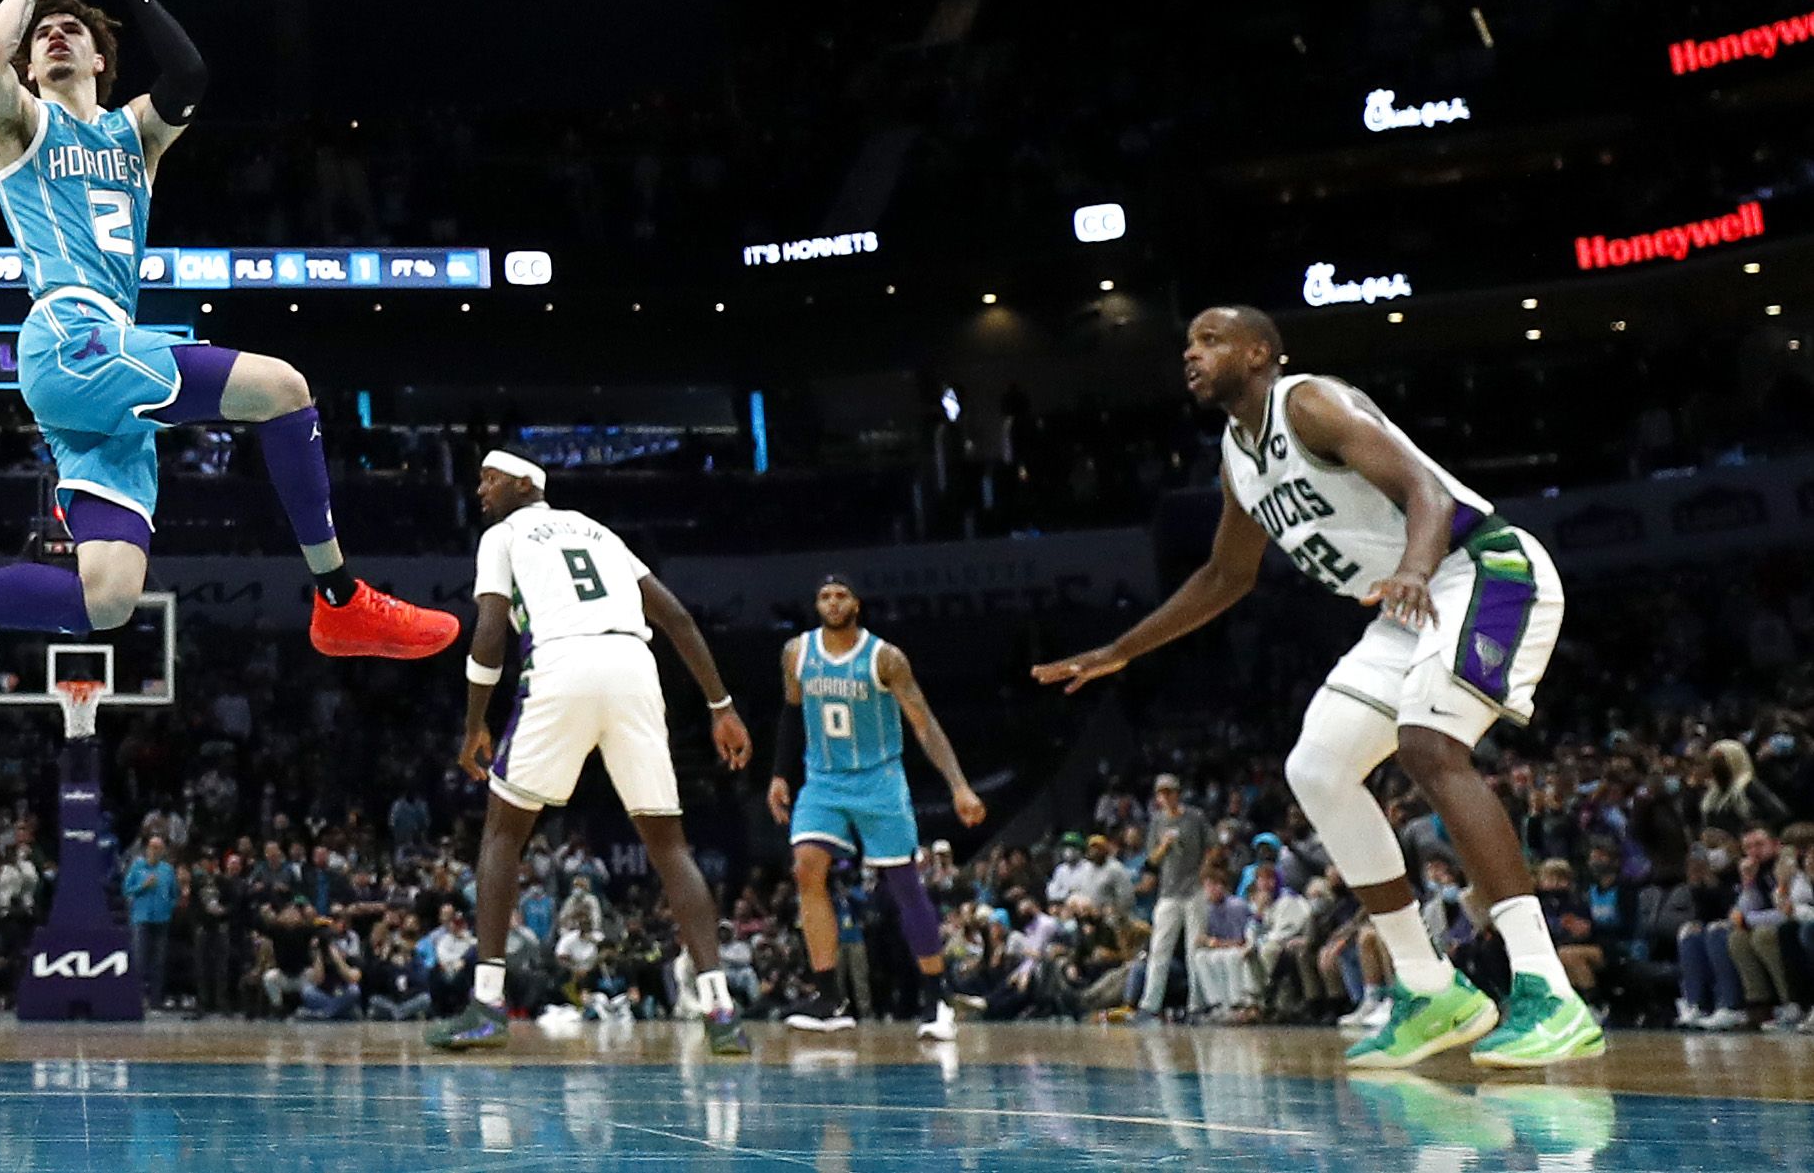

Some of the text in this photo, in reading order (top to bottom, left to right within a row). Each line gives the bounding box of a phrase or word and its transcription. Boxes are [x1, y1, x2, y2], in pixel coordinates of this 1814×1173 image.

[88, 188, 135, 256] 2
[1575, 202, 1765, 270] Honeywell
[179, 250, 229, 280] CHA
[234, 259, 273, 280] FLS
[305, 260, 347, 280] TOL
[359, 258, 372, 280] 1
[743, 231, 878, 266] IT'S HORNETS
[561, 548, 609, 603] 9
[822, 702, 852, 740] 0
[32, 951, 128, 977] KIA
